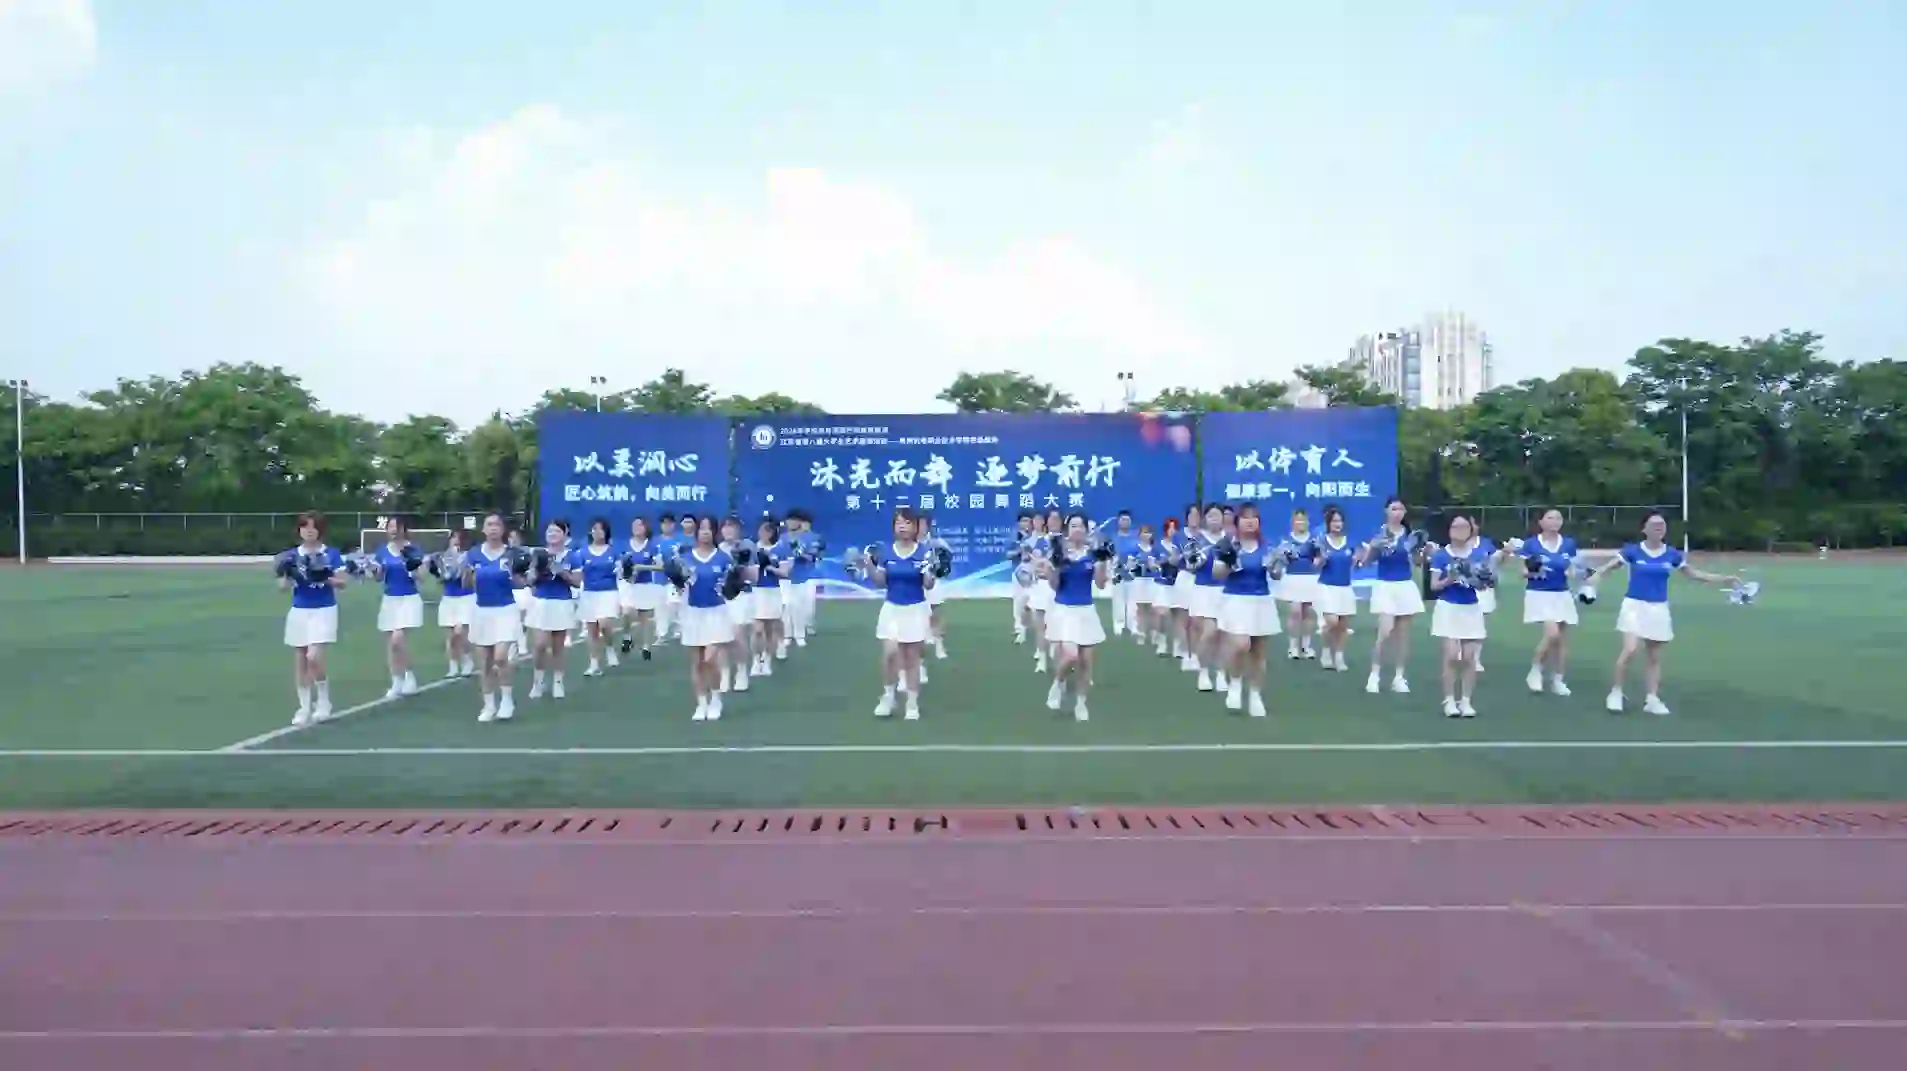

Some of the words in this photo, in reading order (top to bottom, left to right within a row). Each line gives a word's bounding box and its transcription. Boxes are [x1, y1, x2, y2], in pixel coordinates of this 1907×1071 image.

[810, 452, 953, 494] 沐光而舞
[974, 454, 1121, 490] 逐梦前行
[1235, 444, 1364, 475] 以体育人
[846, 493, 1084, 511] 第十二届校园舞蹈大赛
